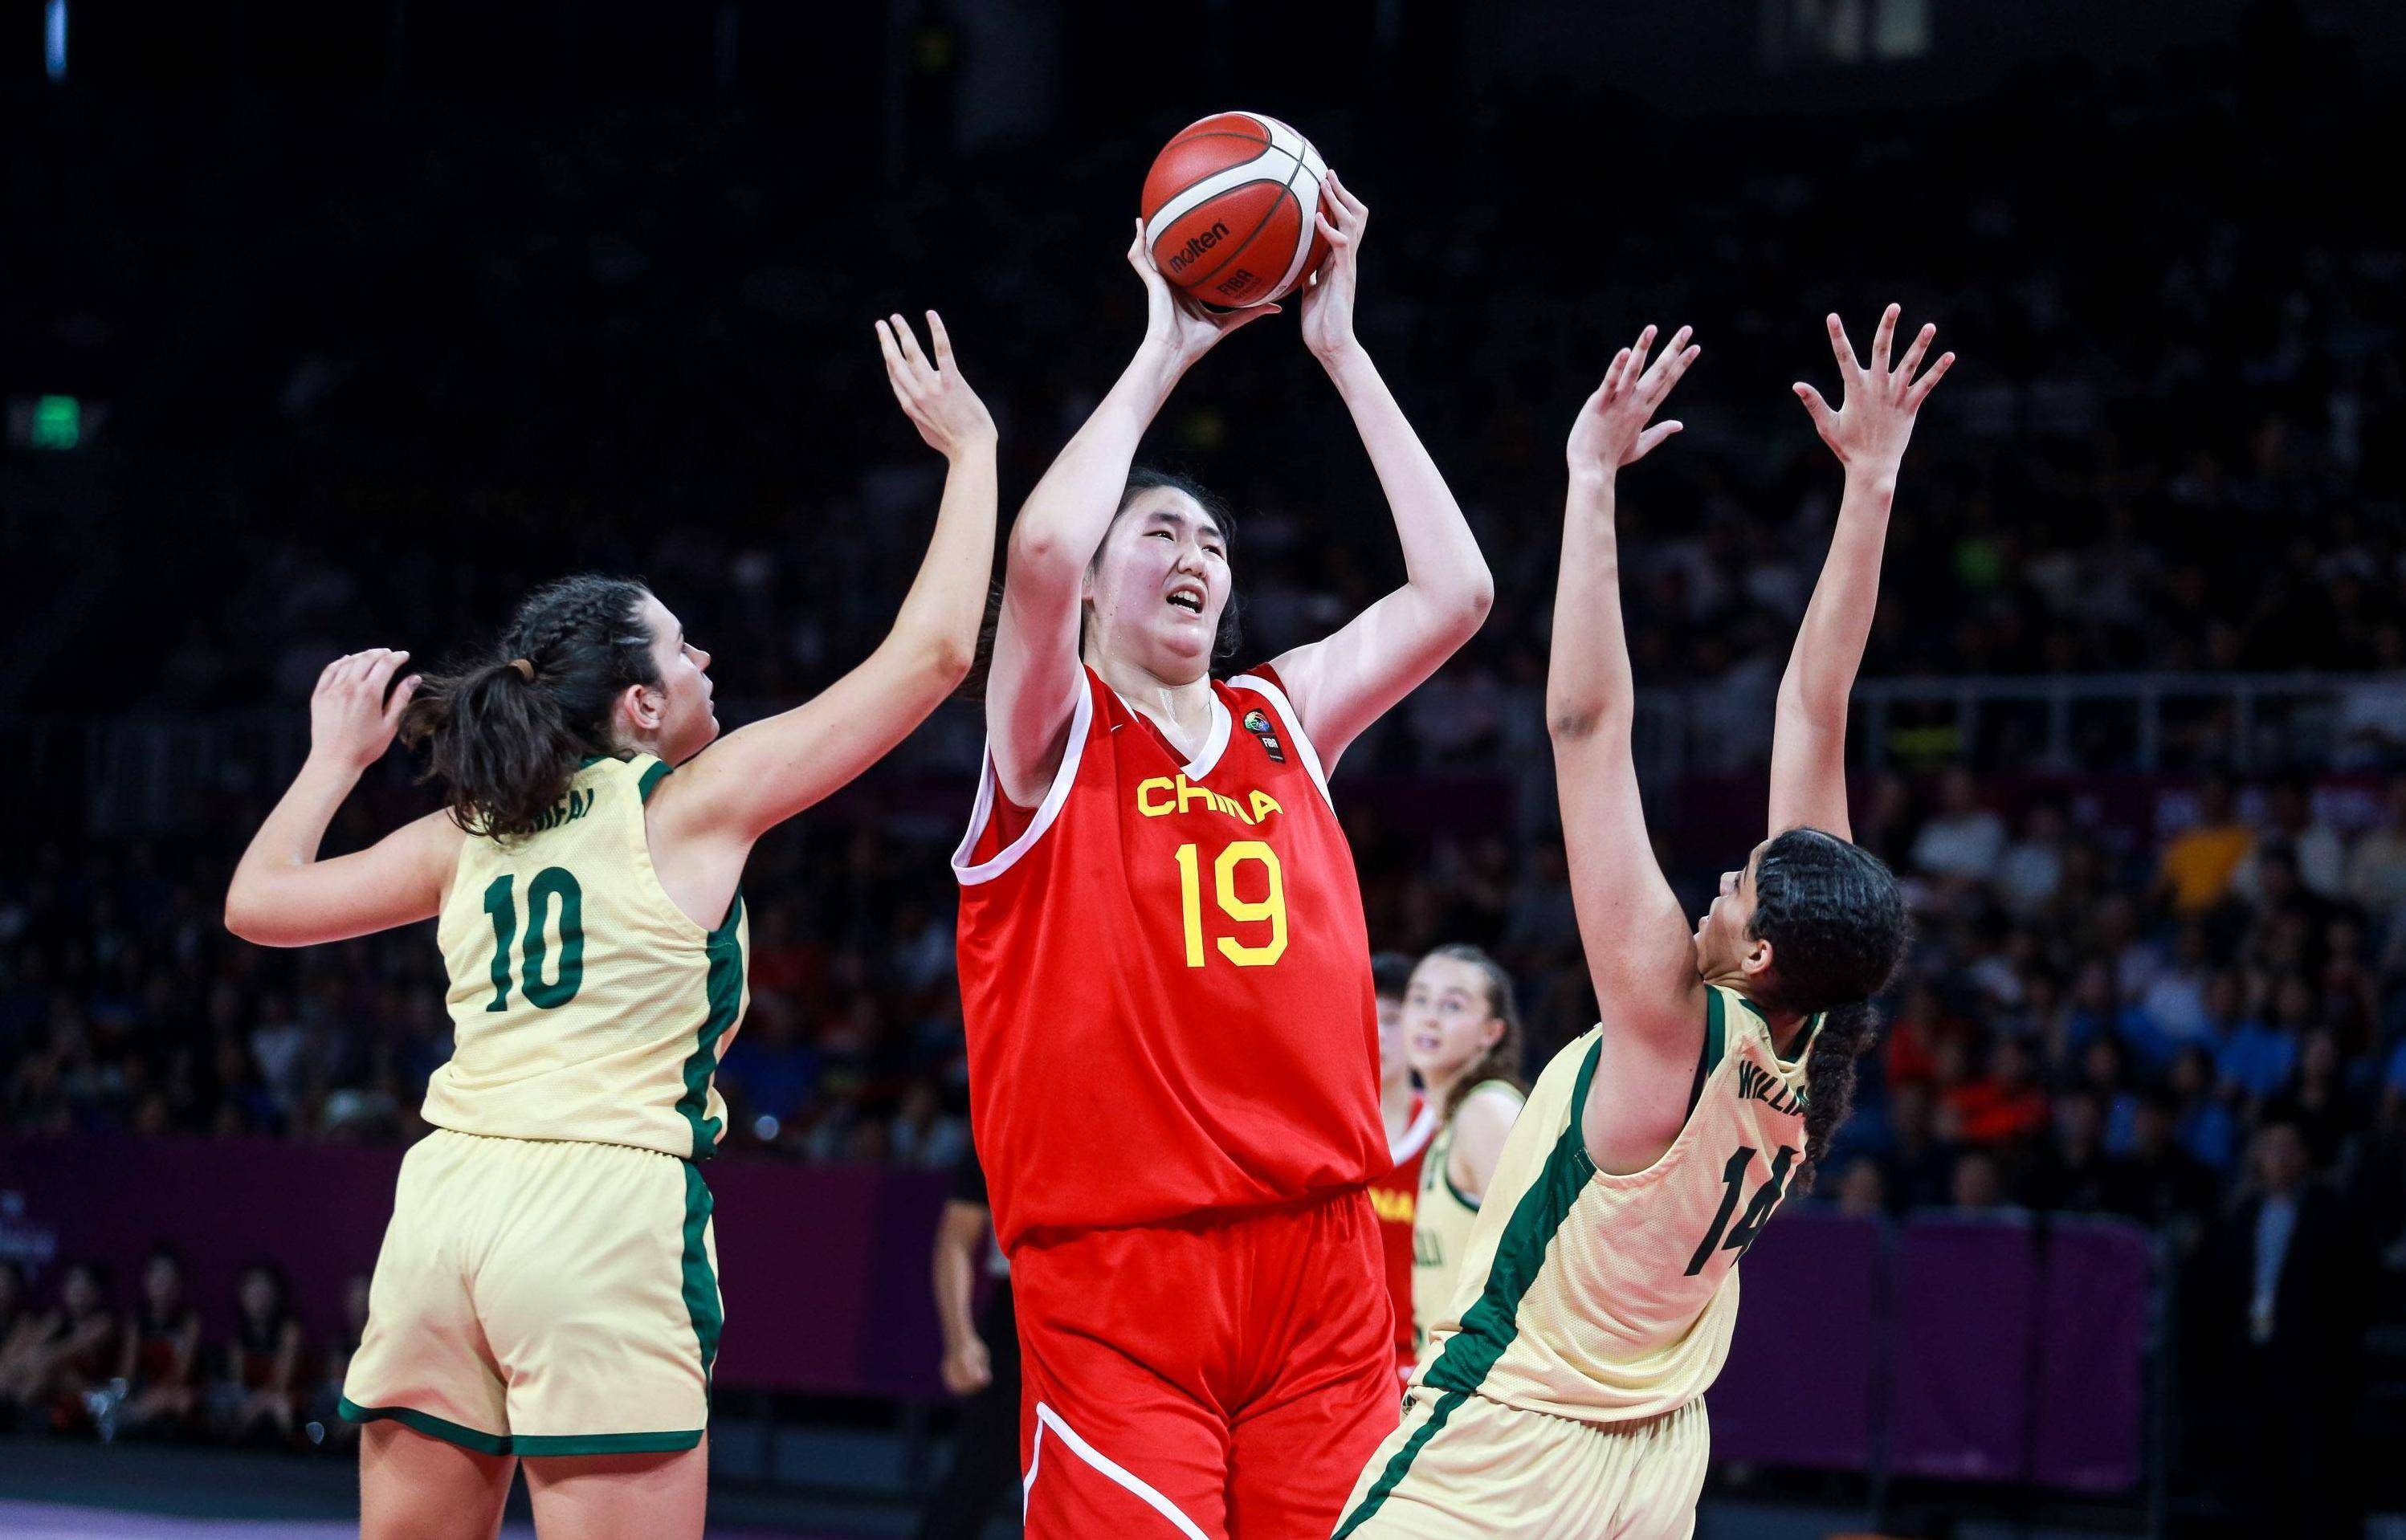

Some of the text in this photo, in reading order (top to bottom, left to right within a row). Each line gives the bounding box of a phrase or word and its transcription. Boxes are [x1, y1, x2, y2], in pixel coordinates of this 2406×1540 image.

[1169, 222, 1230, 274] molten
[1217, 269, 1254, 296] FIBA
[483, 866, 585, 1012] 10
[1174, 841, 1288, 968] 19
[1738, 1060, 1809, 1116] WILLI
[1683, 1145, 1800, 1276] 14
